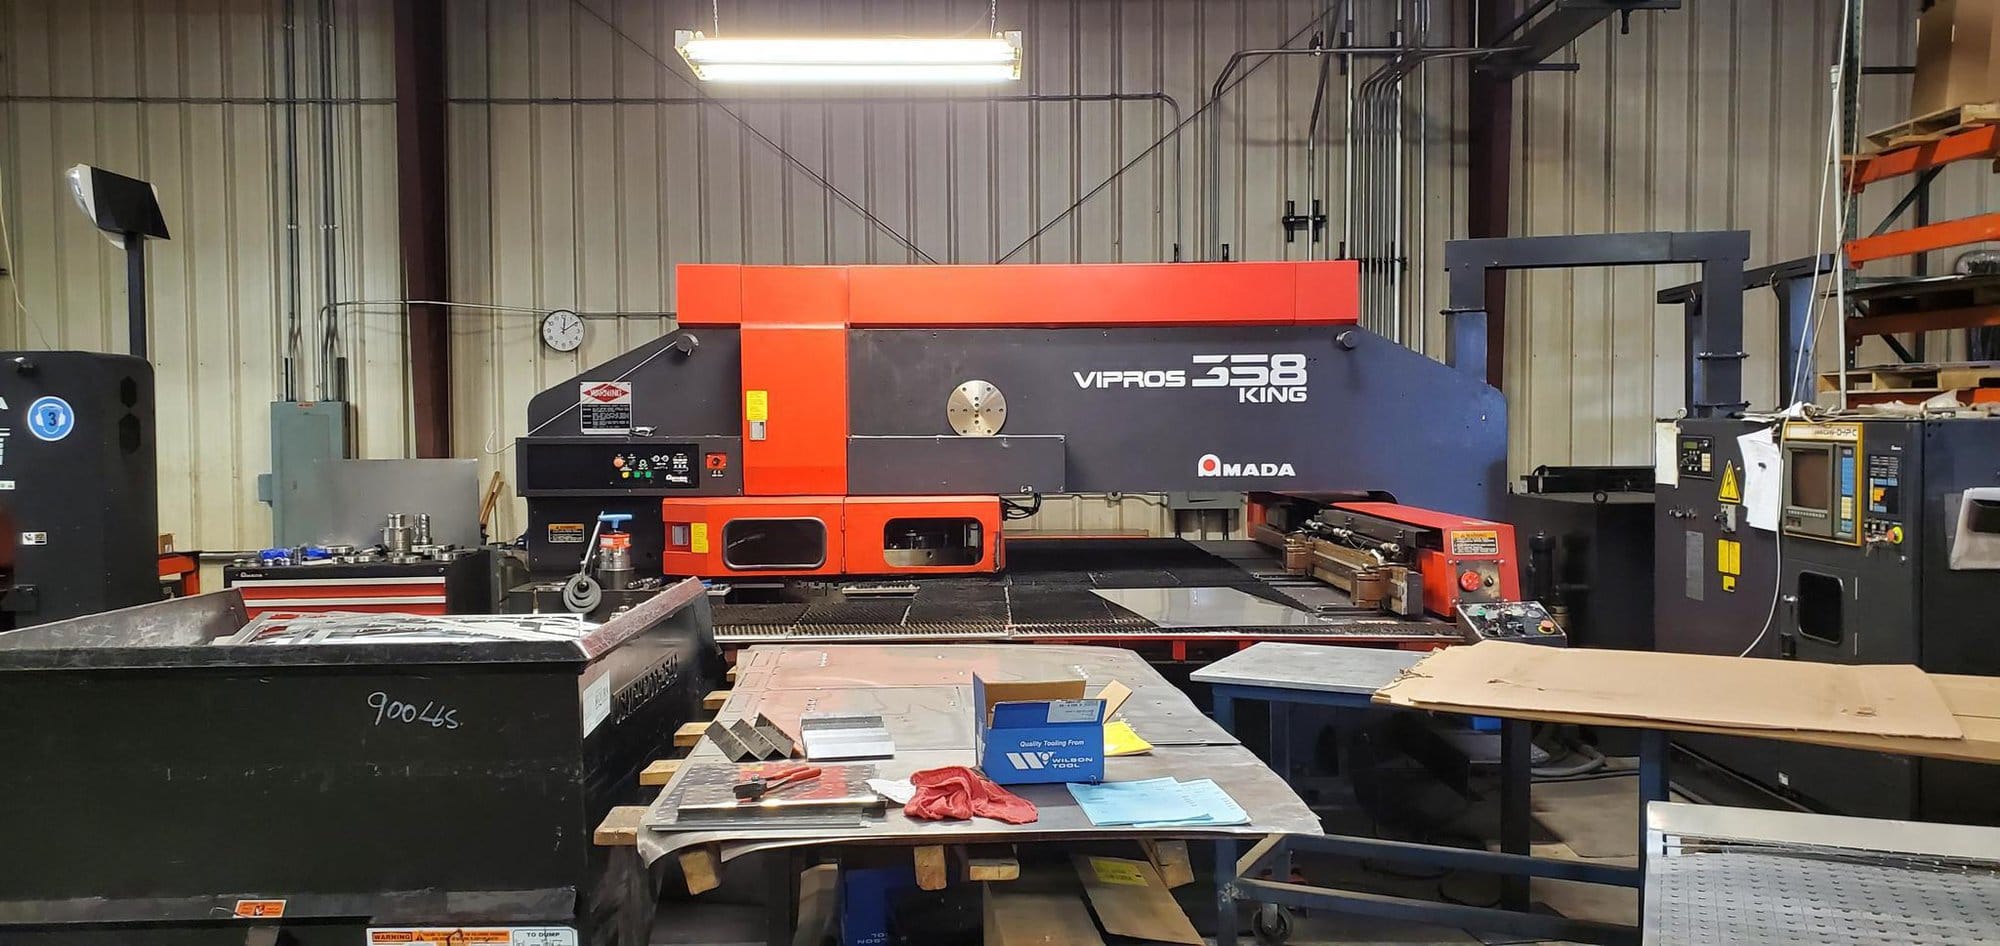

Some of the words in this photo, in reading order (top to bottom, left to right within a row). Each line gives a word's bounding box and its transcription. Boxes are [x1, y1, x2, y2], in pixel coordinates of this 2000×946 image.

[1073, 370, 1186, 389] VIPROS
[1191, 353, 1308, 388] 358
[1239, 387, 1308, 403] KING
[47, 411, 58, 427] 3
[1197, 453, 1297, 478] AMADA
